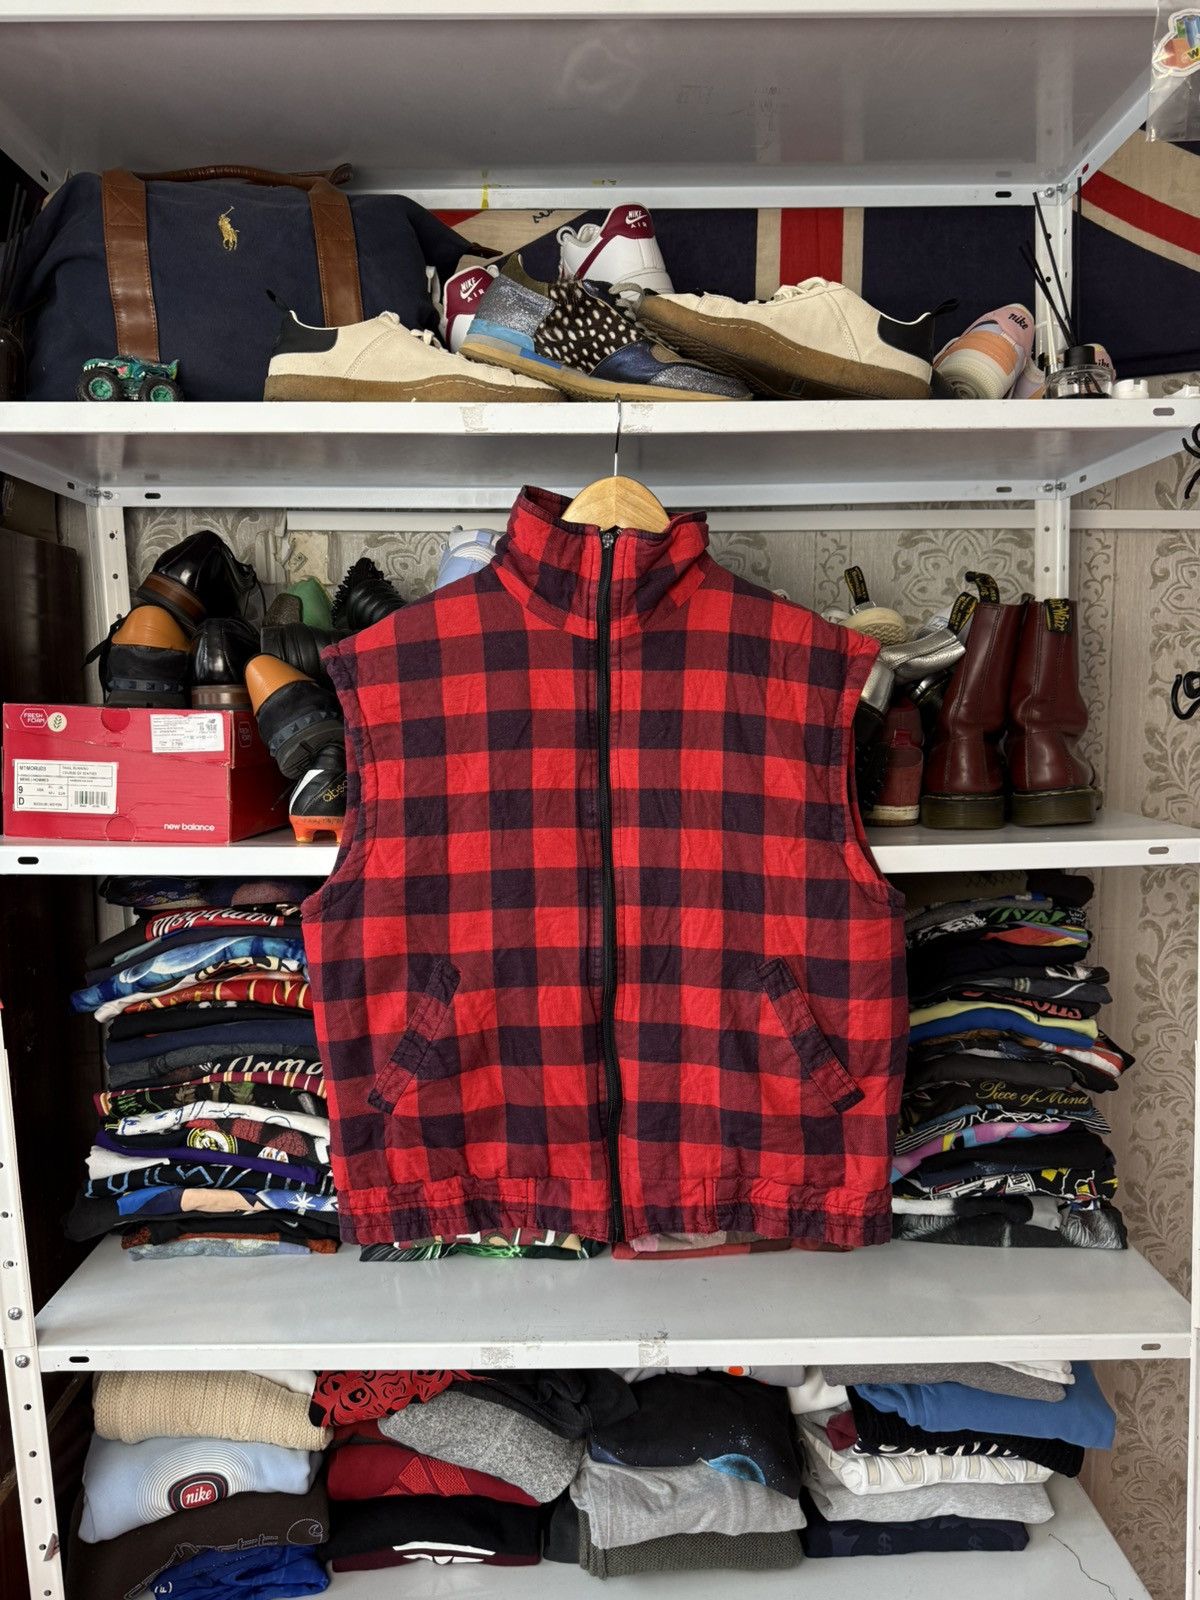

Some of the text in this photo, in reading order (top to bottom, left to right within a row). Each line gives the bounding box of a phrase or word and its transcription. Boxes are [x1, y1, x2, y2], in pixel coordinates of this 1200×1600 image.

[628, 210, 642, 219] NIKE
[631, 221, 647, 229] AIR
[460, 277, 476, 292] NIKE
[467, 289, 485, 303] AIR
[1008, 313, 1029, 330] nike
[18, 786, 24, 794] 9
[18, 797, 25, 805] D
[181, 823, 215, 832] balance
[976, 1081, 1089, 1107] Piece of Mind
[186, 1486, 212, 1505] nike
